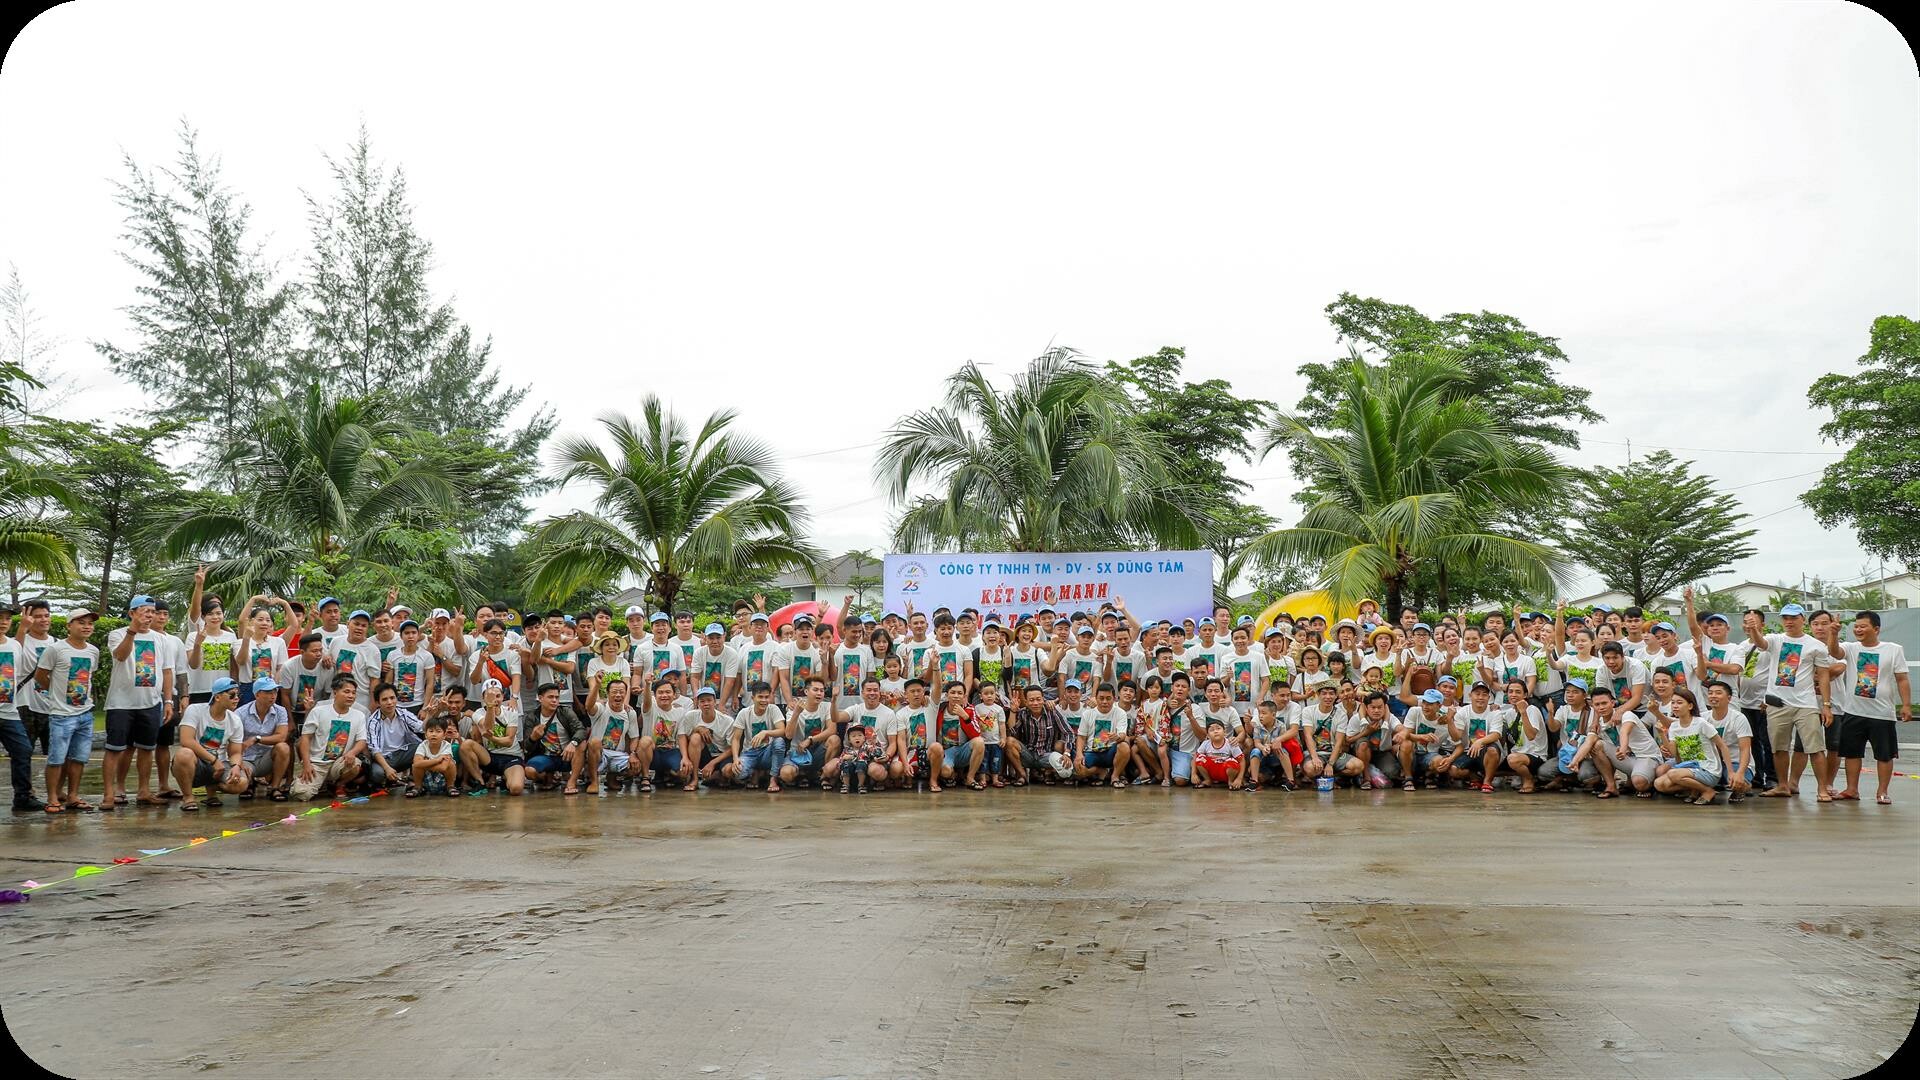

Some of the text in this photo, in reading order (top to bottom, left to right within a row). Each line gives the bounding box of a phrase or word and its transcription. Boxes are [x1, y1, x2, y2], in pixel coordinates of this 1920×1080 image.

[939, 561, 974, 575] CÔNG
[979, 564, 992, 574] TY
[998, 564, 1030, 574] TNHH
[1035, 563, 1051, 574] TM
[1066, 563, 1082, 574] DV
[1097, 562, 1112, 574] SX
[1158, 559, 1184, 573] TÂM
[902, 580, 919, 591] 25
[980, 582, 1015, 604] KẾT
[1058, 582, 1108, 604] MẠNH
